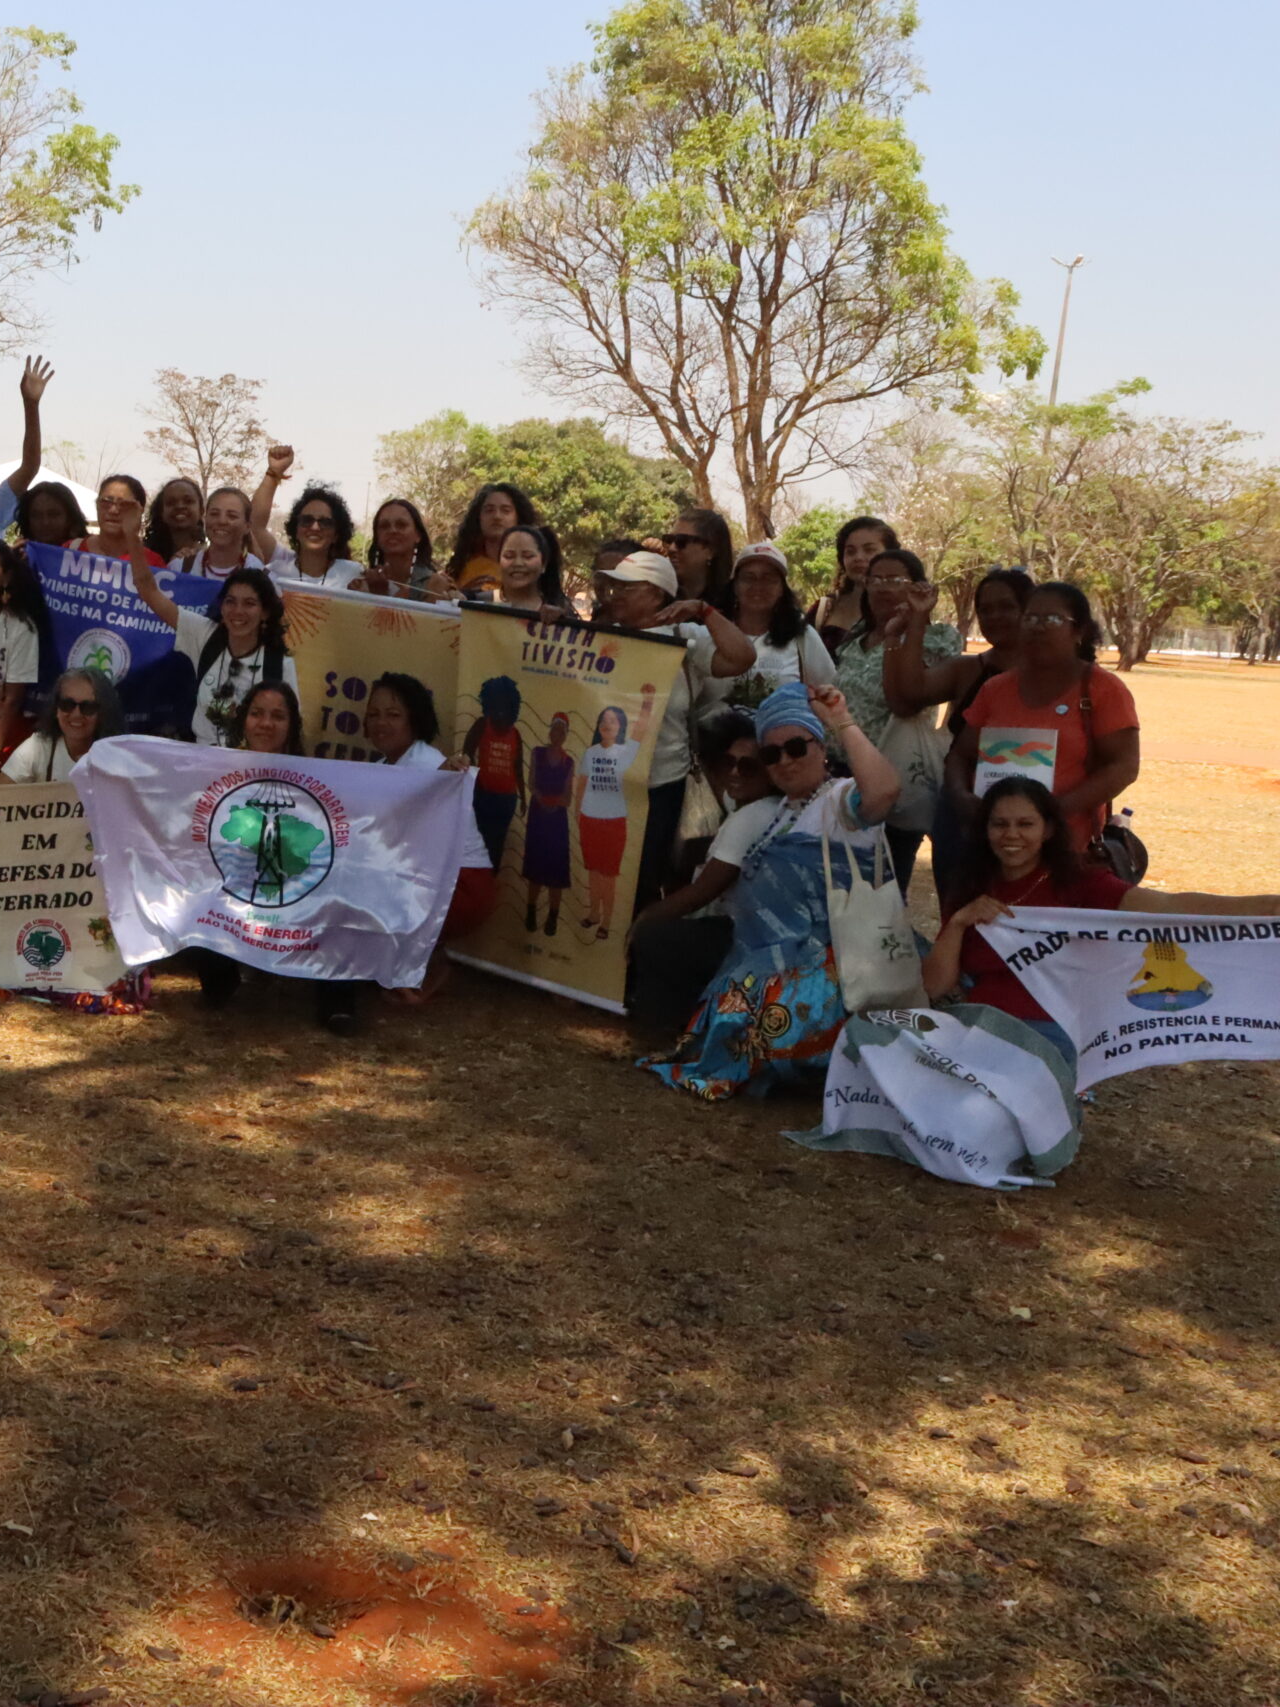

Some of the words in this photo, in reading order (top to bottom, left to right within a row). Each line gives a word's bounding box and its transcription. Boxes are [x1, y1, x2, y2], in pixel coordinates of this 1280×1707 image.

[111, 593, 132, 609] DE
[81, 606, 102, 621] NA
[105, 611, 176, 635] CAMINHA
[522, 641, 616, 674] TIVISMO
[191, 780, 225, 843] MOVIMENTO
[221, 770, 244, 789] DOS
[244, 767, 306, 785] ATINGIDOS
[303, 776, 326, 795] POR
[319, 789, 350, 848] BARRAGENS
[21, 832, 58, 851] EM
[242, 923, 252, 933] E
[254, 925, 313, 940] ENERGIA
[1116, 921, 1280, 943] COMUNIDADE
[1006, 933, 1063, 971] TRAD
[1119, 1015, 1208, 1037] RESISTENCIA
[1211, 1015, 1221, 1026] E
[1104, 1043, 1132, 1060] NO
[1139, 1032, 1253, 1050] PANTANAL
